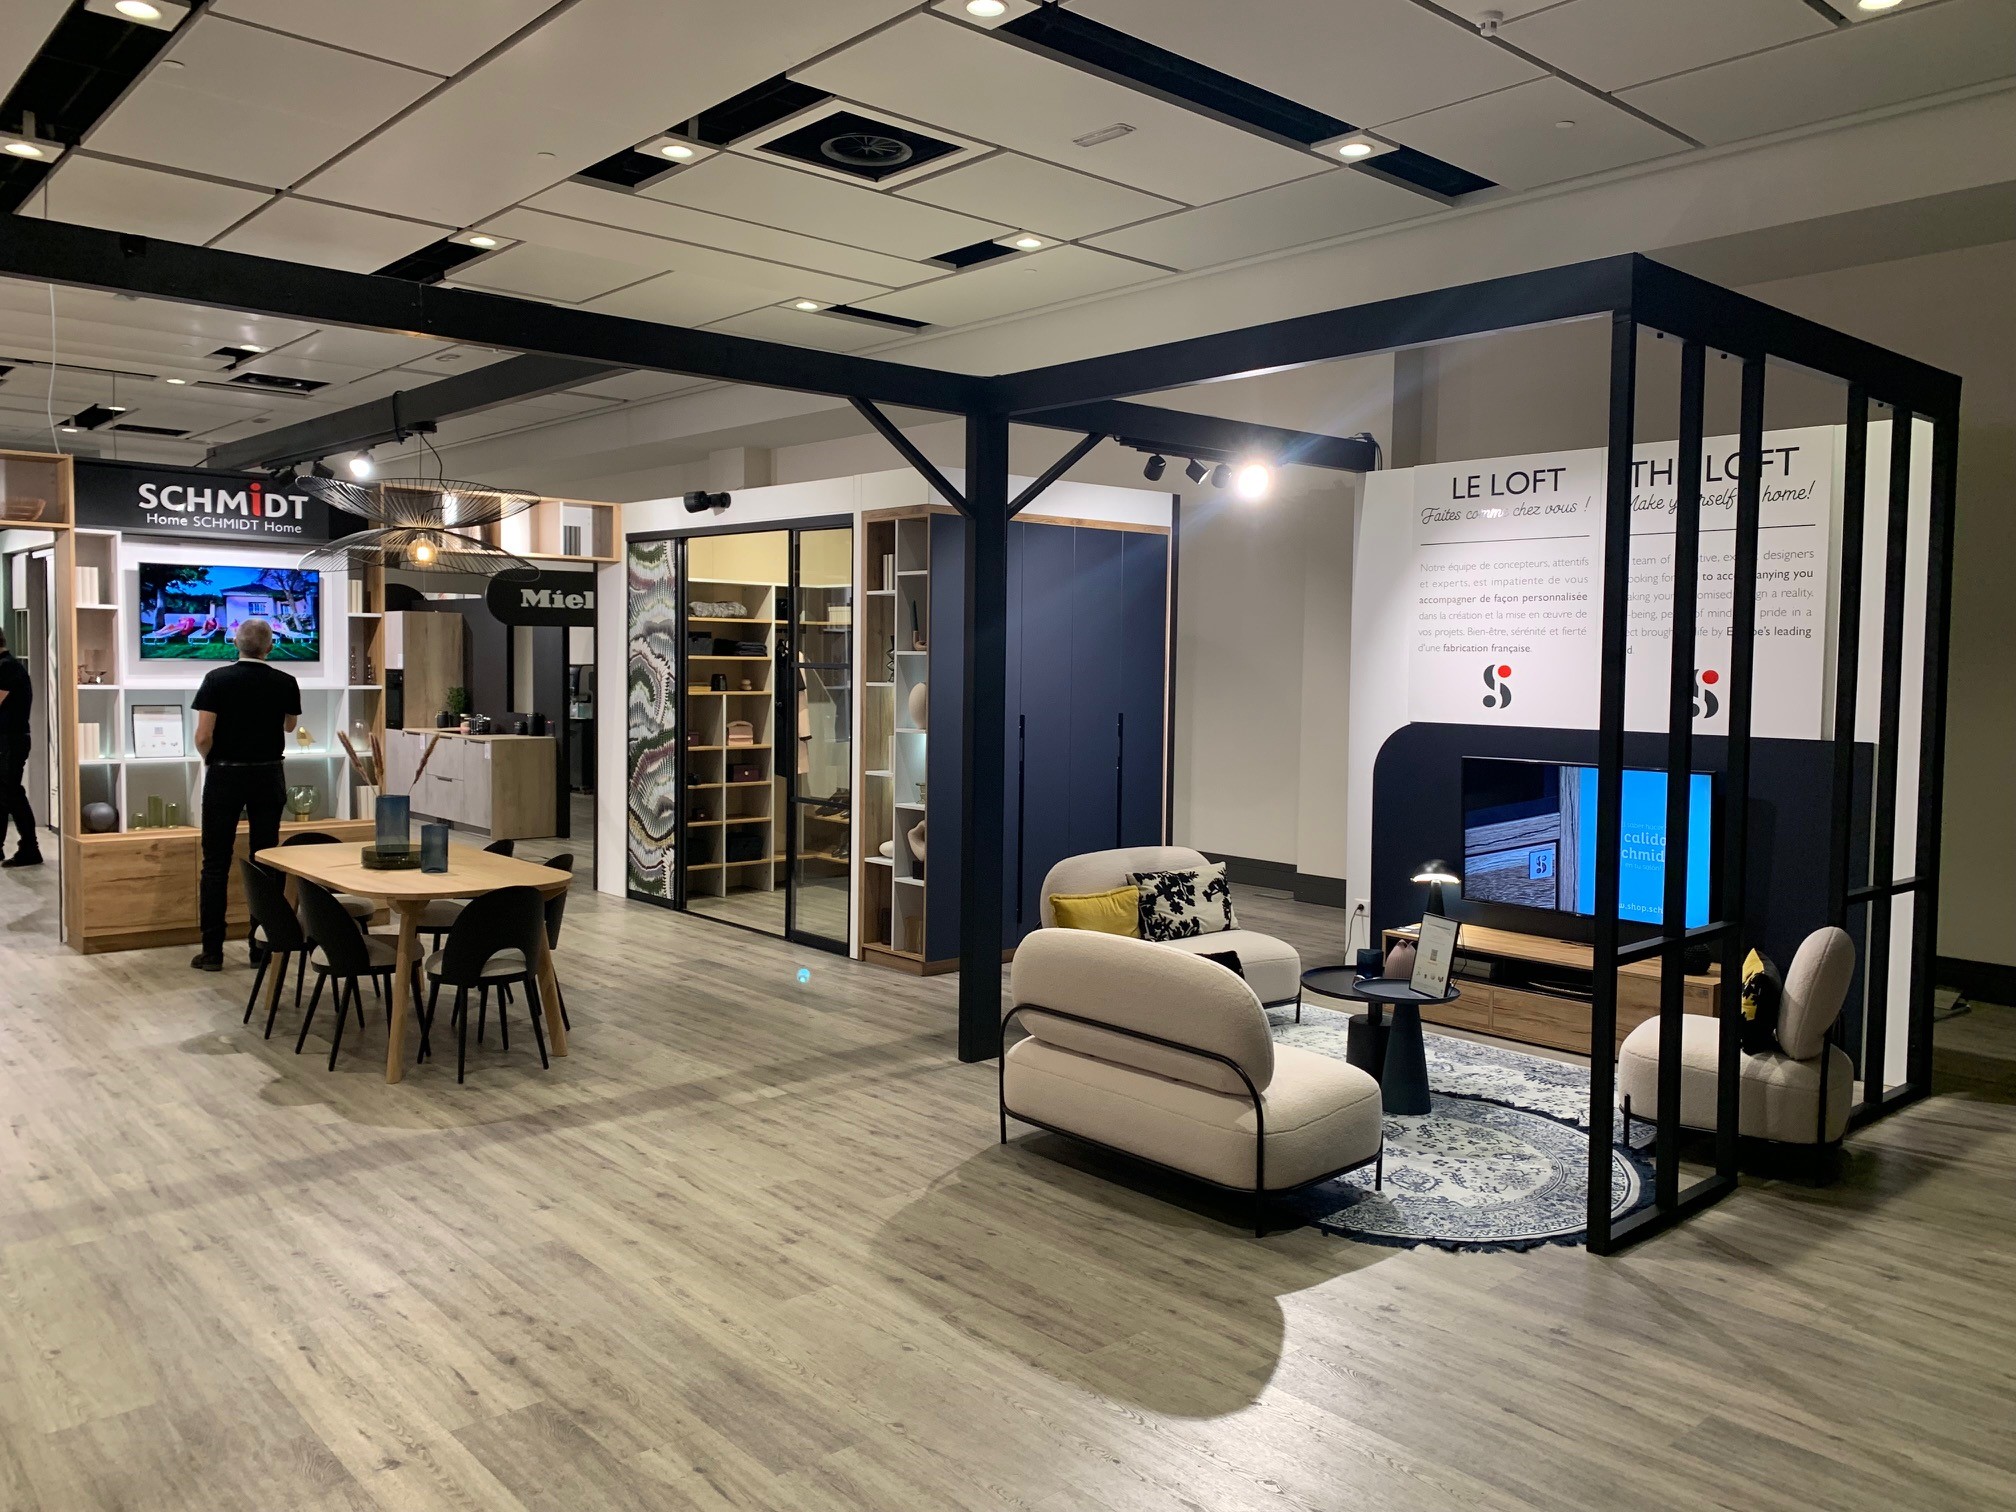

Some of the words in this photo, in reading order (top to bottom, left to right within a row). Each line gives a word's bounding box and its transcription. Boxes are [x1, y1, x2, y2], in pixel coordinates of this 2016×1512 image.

[1631, 458, 1673, 488] TH
[1452, 475, 1480, 500] LE
[1491, 468, 1566, 496] LOFT
[1762, 480, 1816, 502] home!
[1420, 507, 1461, 524] Faites
[1512, 502, 1541, 516] chez
[1544, 502, 1578, 514] vous
[146, 513, 188, 526] Home
[193, 516, 259, 531] SCHMIDT
[264, 522, 302, 534] Home
[1420, 563, 1446, 572] Notre
[1449, 562, 1476, 573] équipe
[1480, 562, 1490, 570] de
[1494, 560, 1550, 570] concepteurs,
[1552, 557, 1589, 568] attentifs
[1632, 558, 1656, 566] team
[1660, 554, 1671, 564] of
[1764, 550, 1814, 562] designers
[1420, 580, 1429, 588] et
[1432, 580, 1470, 590] experts,
[1474, 579, 1487, 587] est
[1491, 576, 1544, 588] impatiente
[1548, 576, 1560, 585] de
[1564, 576, 1588, 584] vous
[1628, 574, 1658, 586] ooking
[1716, 570, 1790, 582] accanying
[1793, 570, 1814, 580] you
[520, 588, 594, 609] Miel
[1418, 596, 1476, 605] accompagner
[1480, 594, 1491, 603] de
[1494, 594, 1519, 604] façon
[1522, 592, 1588, 604] personnalisée
[1628, 592, 1650, 603] aking
[1780, 588, 1814, 600] reality.
[1418, 612, 1438, 620] dans
[1440, 611, 1446, 620] la
[1449, 610, 1482, 620] création
[1485, 612, 1494, 620] et
[1496, 610, 1504, 619] la
[1506, 610, 1526, 619] mise
[1576, 610, 1588, 618] de
[1708, 608, 1732, 618] mind
[1760, 607, 1787, 620] pride
[1792, 606, 1801, 616] in
[1418, 628, 1432, 636] vos
[1434, 627, 1464, 638] projets.
[1468, 627, 1508, 637] Bien-être,
[1511, 626, 1546, 636] sérénité
[1550, 627, 1559, 636] et
[1562, 626, 1587, 636] fierté
[1712, 627, 1724, 638] by
[1774, 626, 1812, 638] leading
[1443, 643, 1488, 652] fabrication
